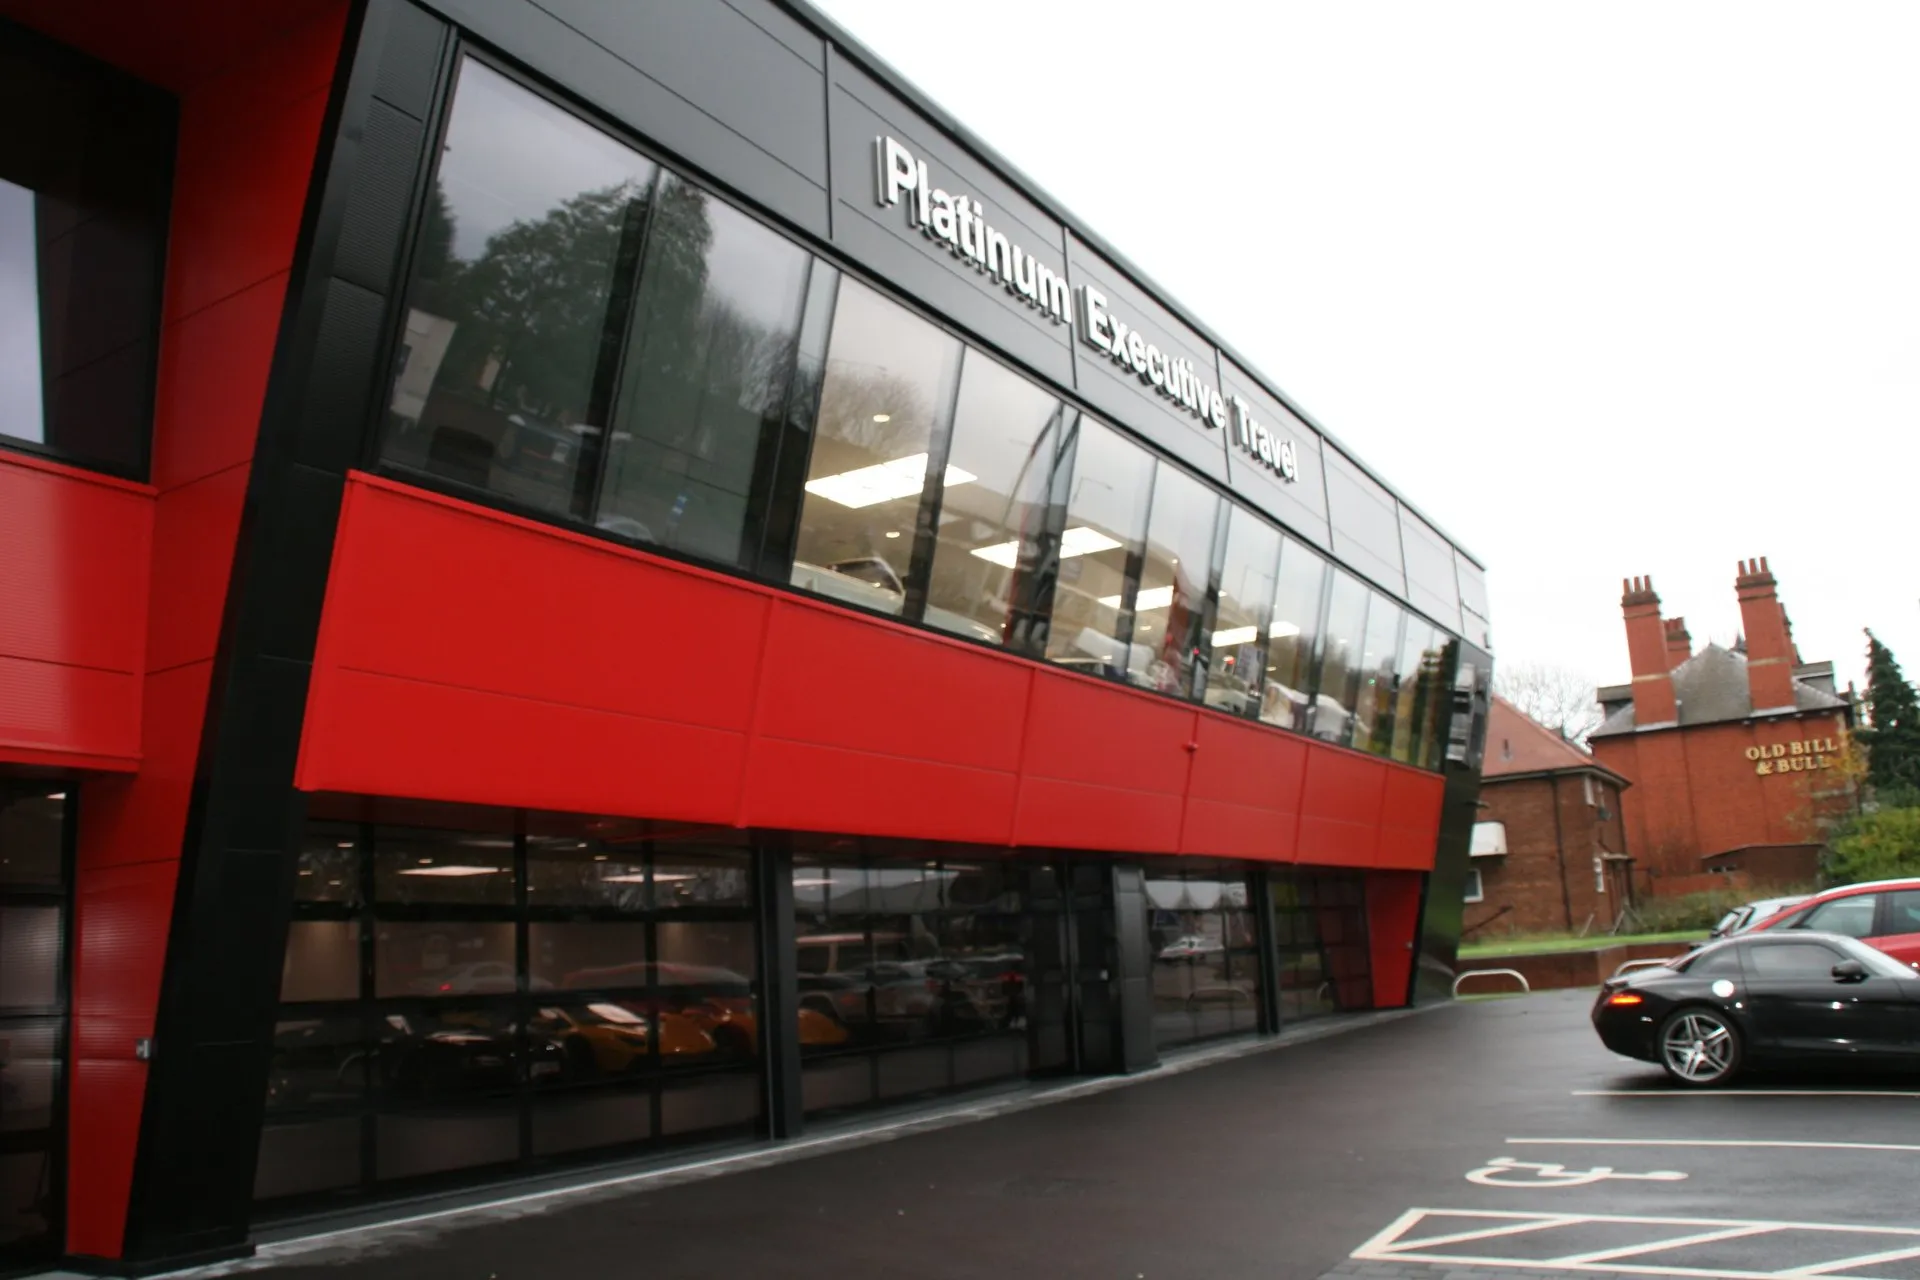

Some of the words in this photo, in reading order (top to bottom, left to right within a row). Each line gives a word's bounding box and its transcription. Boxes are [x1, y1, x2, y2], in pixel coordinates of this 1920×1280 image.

[874, 136, 1072, 326] Platinum
[1076, 284, 1226, 430] Executive
[1226, 395, 1299, 482] Travel
[1745, 743, 1786, 760] OLD
[1789, 738, 1838, 755] BILL
[1755, 760, 1773, 775] &
[1776, 755, 1831, 773] BULL
